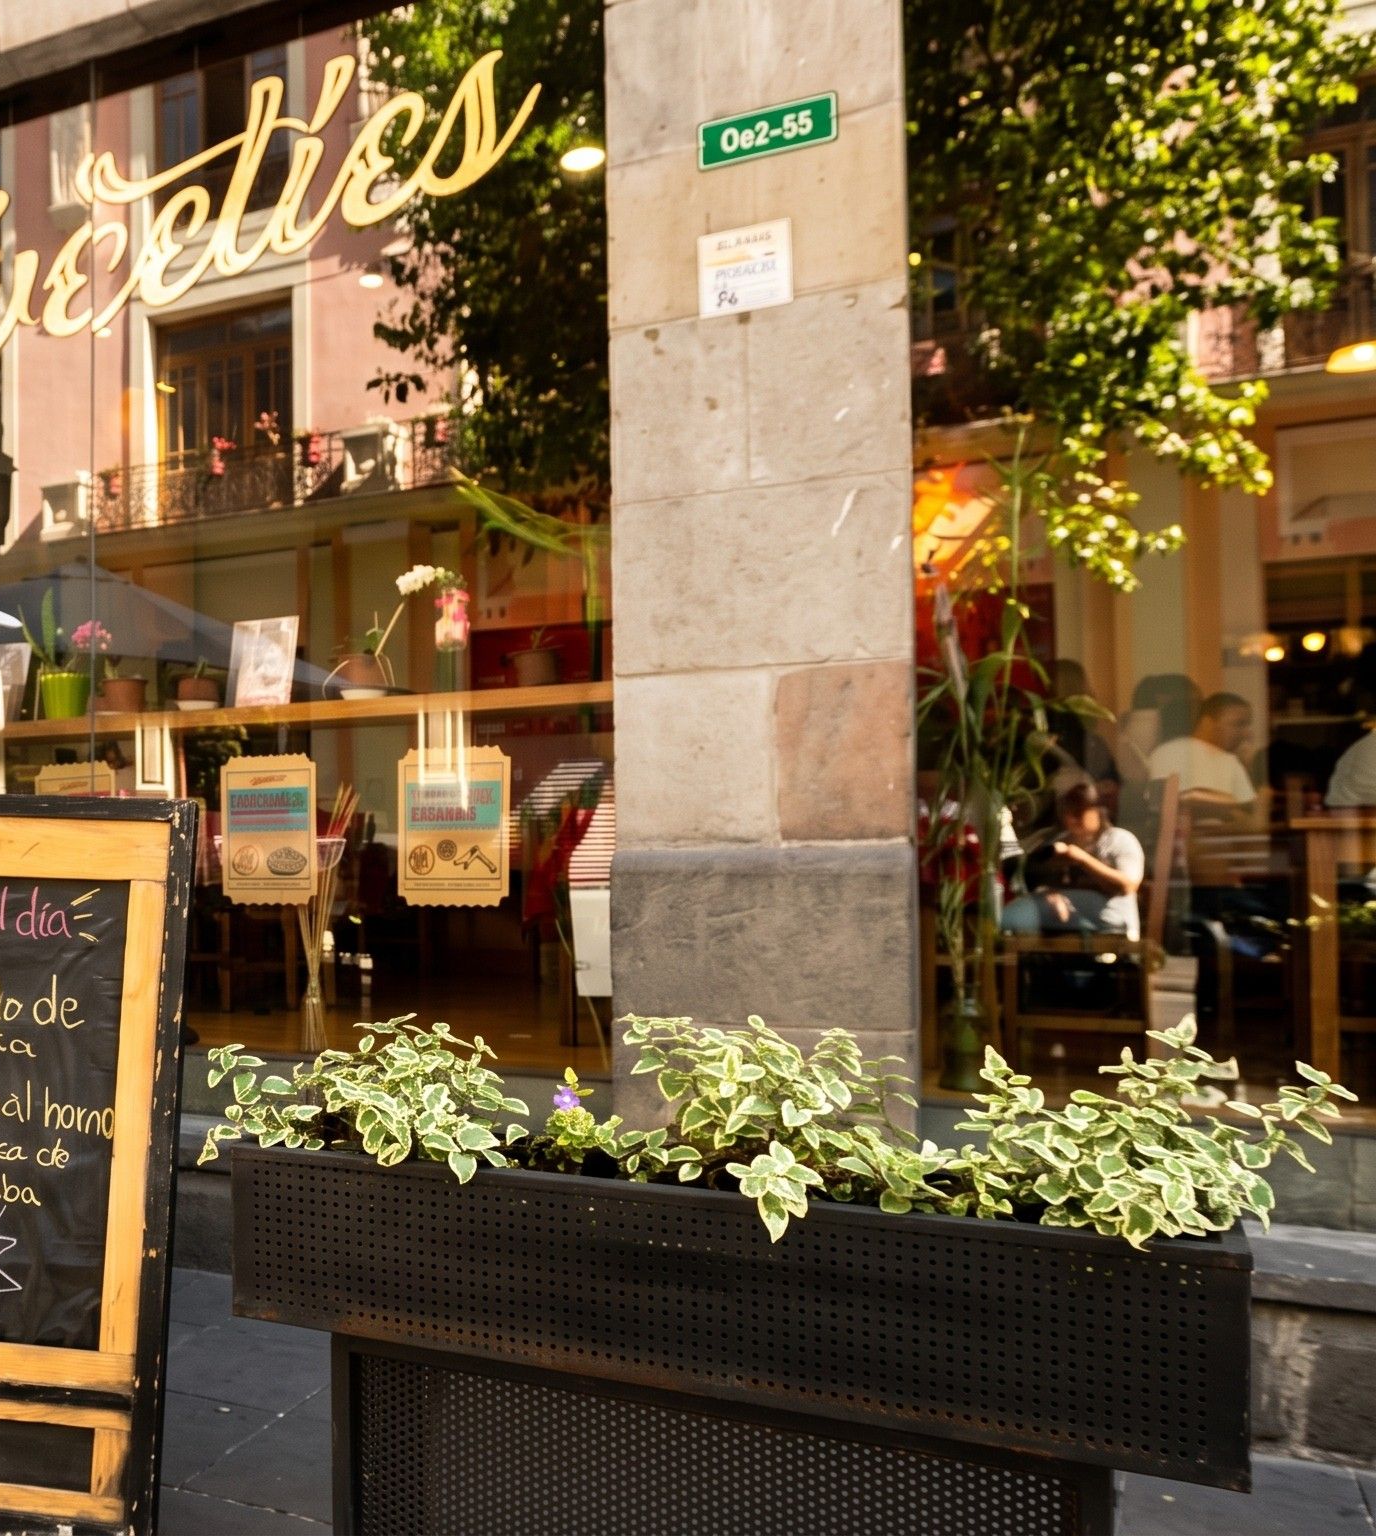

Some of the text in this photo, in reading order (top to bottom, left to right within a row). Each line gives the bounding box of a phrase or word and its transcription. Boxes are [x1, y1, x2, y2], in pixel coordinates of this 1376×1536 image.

[720, 109, 814, 154] Oe2-55
[16, 886, 72, 939] día
[33, 974, 85, 1029] de
[44, 1086, 115, 1139] horno
